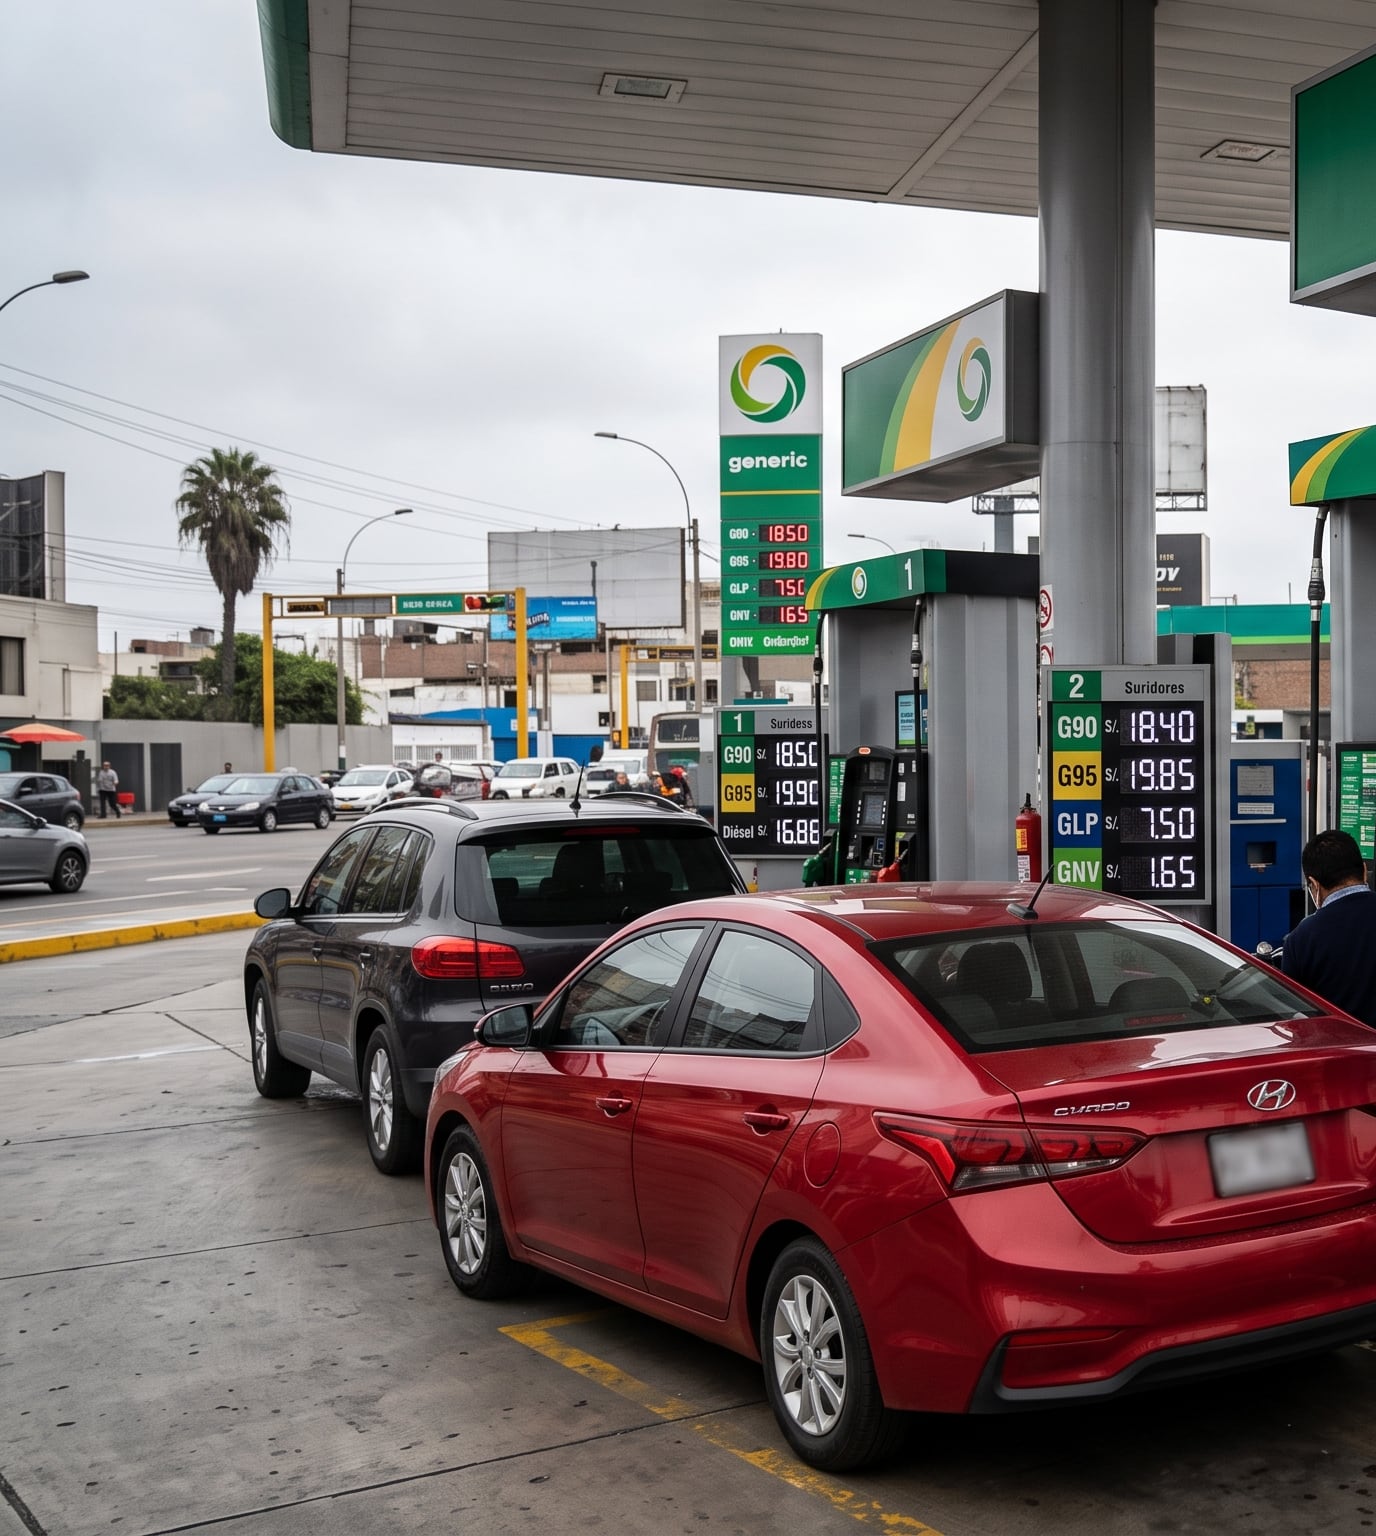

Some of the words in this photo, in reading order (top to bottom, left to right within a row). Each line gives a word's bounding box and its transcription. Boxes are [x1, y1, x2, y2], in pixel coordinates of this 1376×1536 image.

[728, 450, 808, 474] generic
[729, 583, 749, 595] GLP
[903, 557, 913, 591] 1
[1068, 673, 1085, 699] 2
[1124, 680, 1185, 696] Suridores
[733, 712, 742, 733] 1
[1057, 715, 1098, 739] G90
[1105, 718, 1120, 734] S/.
[1130, 710, 1195, 744] 18.40
[724, 745, 752, 764] G90
[1057, 764, 1098, 788] G95
[1105, 767, 1120, 783] S/.
[1130, 758, 1195, 792] 19.85
[1057, 812, 1099, 836] GLP
[1105, 815, 1120, 831] S/.
[1140, 807, 1195, 841] 7.50
[1057, 859, 1101, 883] GNV
[1106, 862, 1121, 879] S/.
[1150, 855, 1195, 889] 1.65
